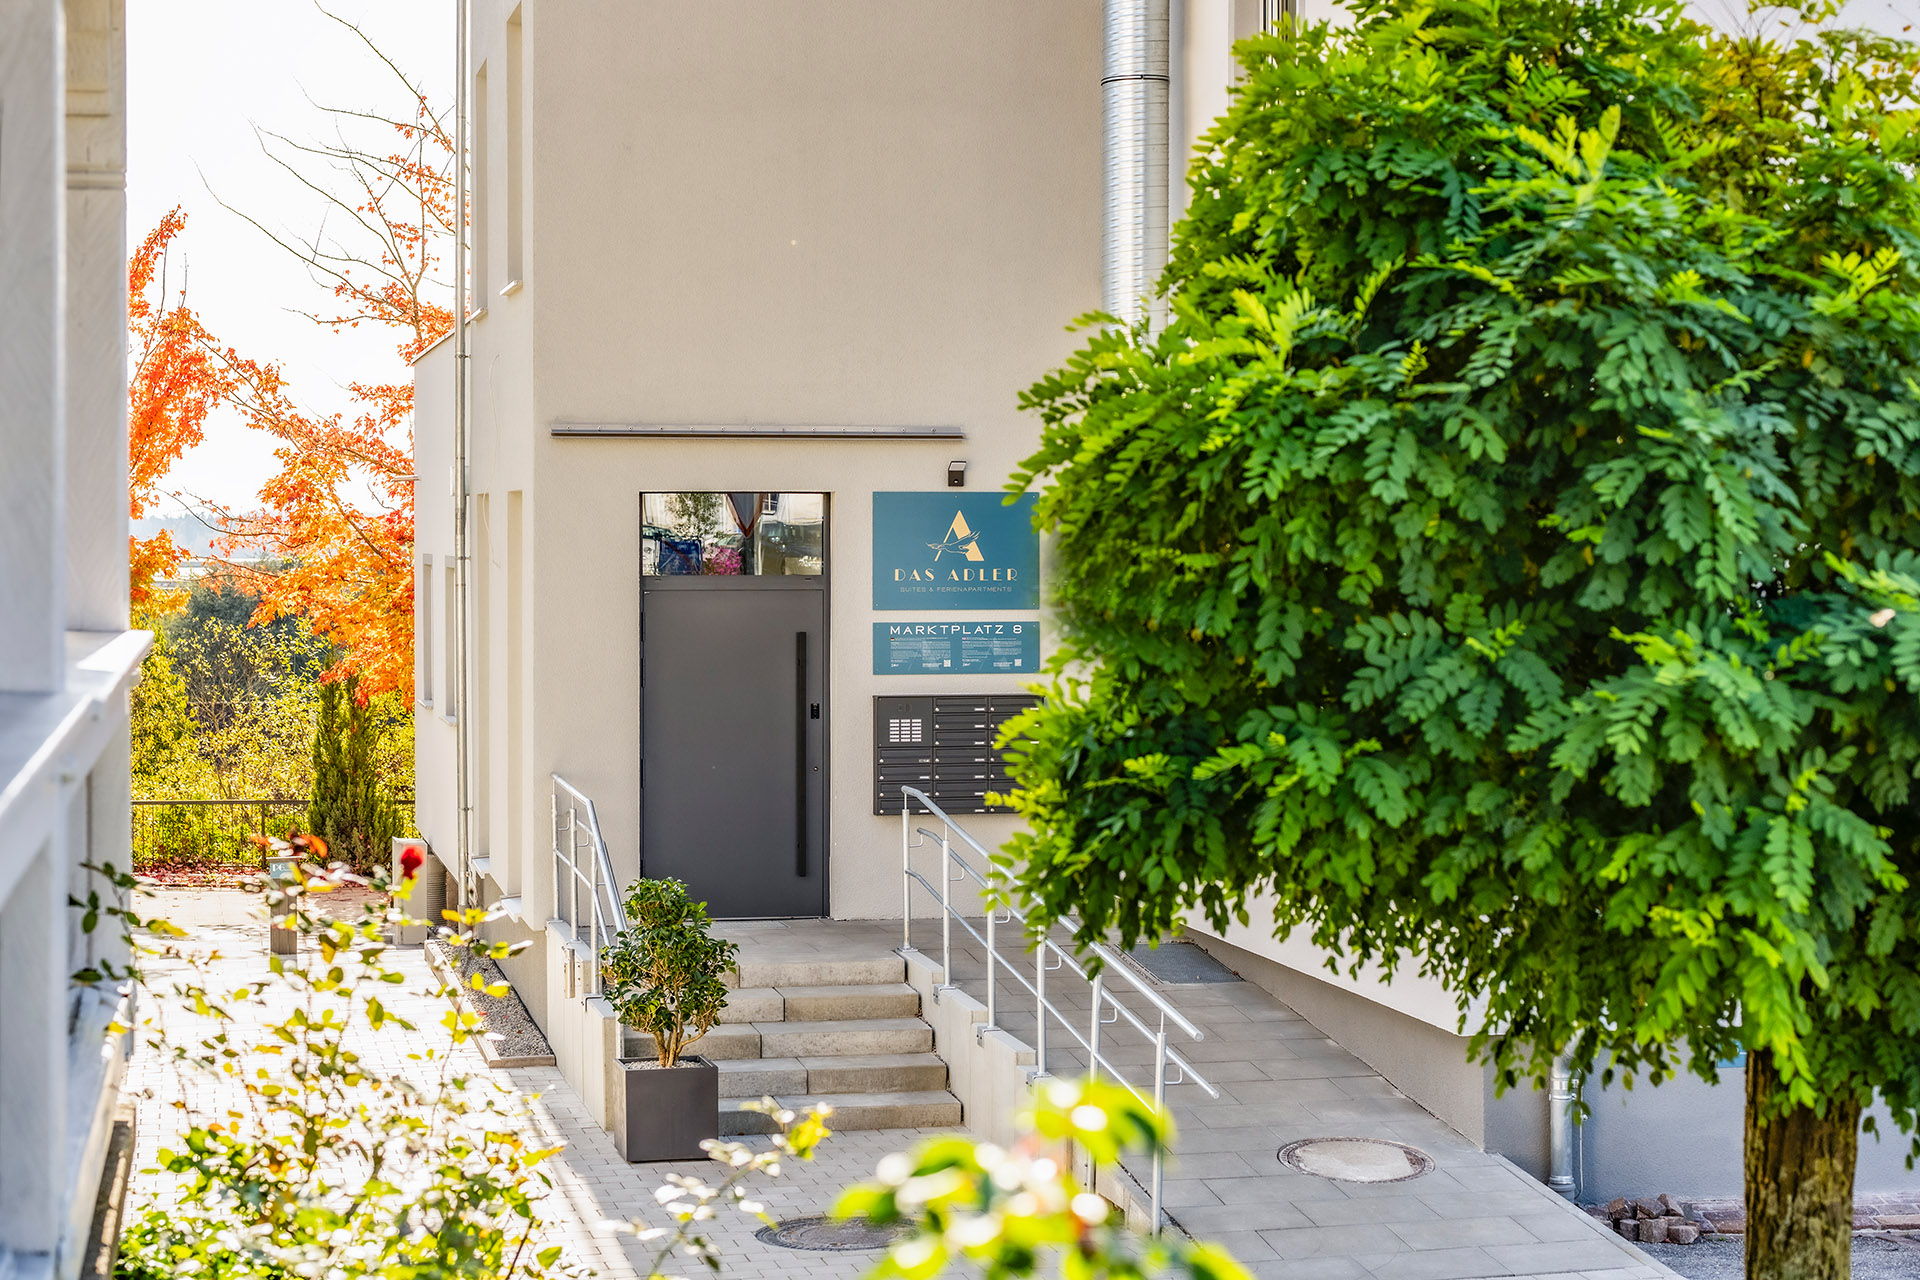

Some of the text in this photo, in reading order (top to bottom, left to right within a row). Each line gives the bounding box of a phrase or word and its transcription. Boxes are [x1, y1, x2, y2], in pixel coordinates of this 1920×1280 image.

[894, 568, 1018, 582] DAS ADLER
[890, 624, 1023, 635] MARKTPLATZ 8
